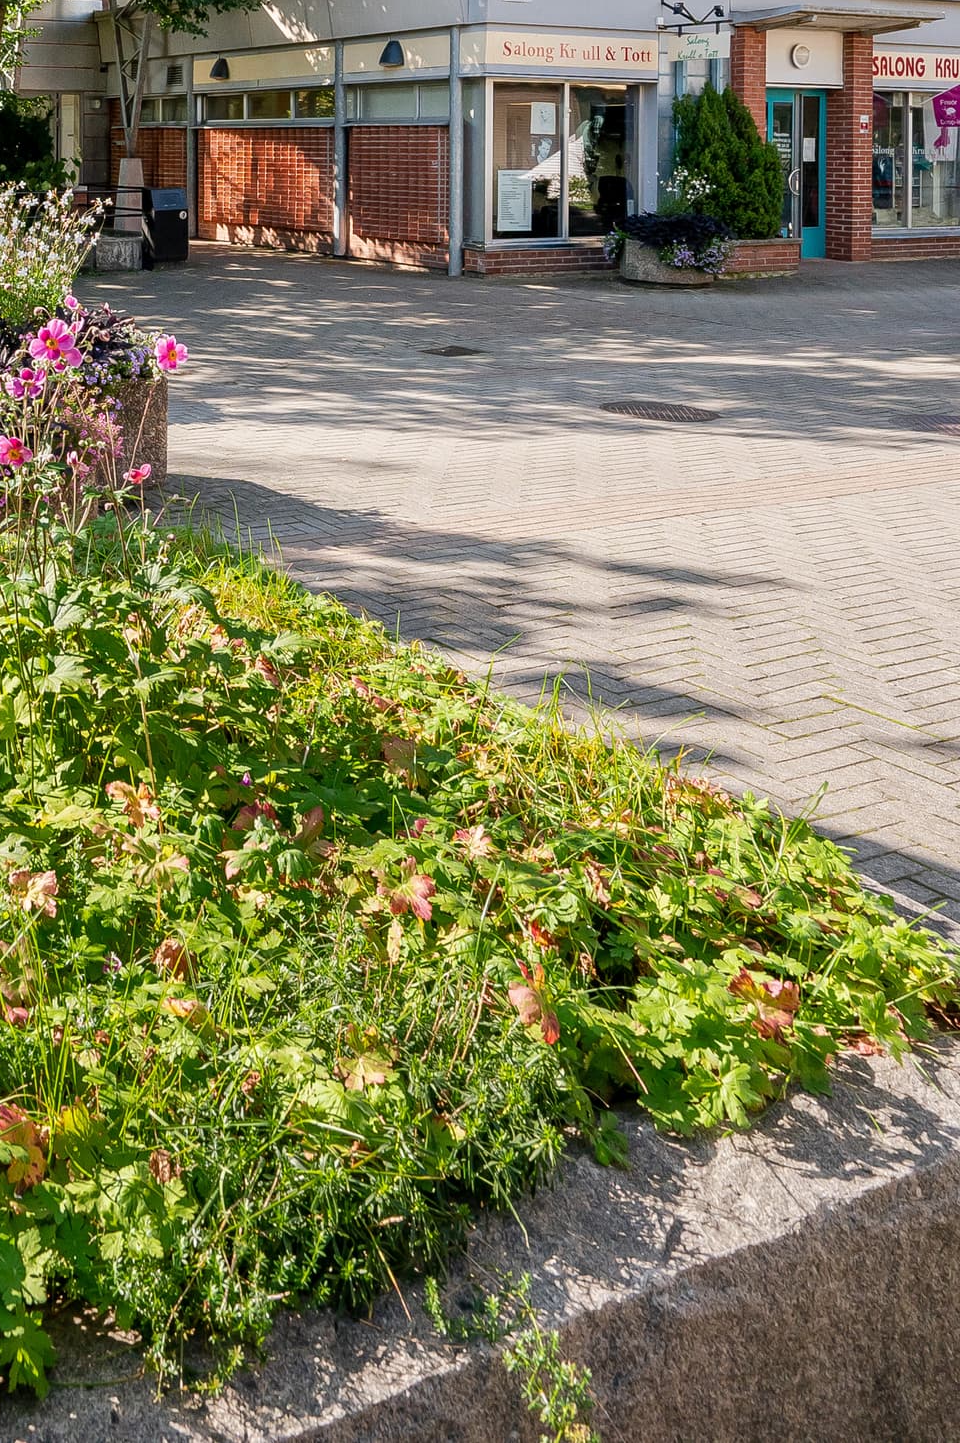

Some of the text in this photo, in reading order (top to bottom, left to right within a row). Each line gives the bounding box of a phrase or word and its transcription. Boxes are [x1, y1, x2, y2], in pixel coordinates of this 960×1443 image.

[502, 40, 555, 63] Salong
[605, 46, 617, 62] &
[621, 46, 652, 63] Tott
[872, 56, 959, 78] SALONG KRU
